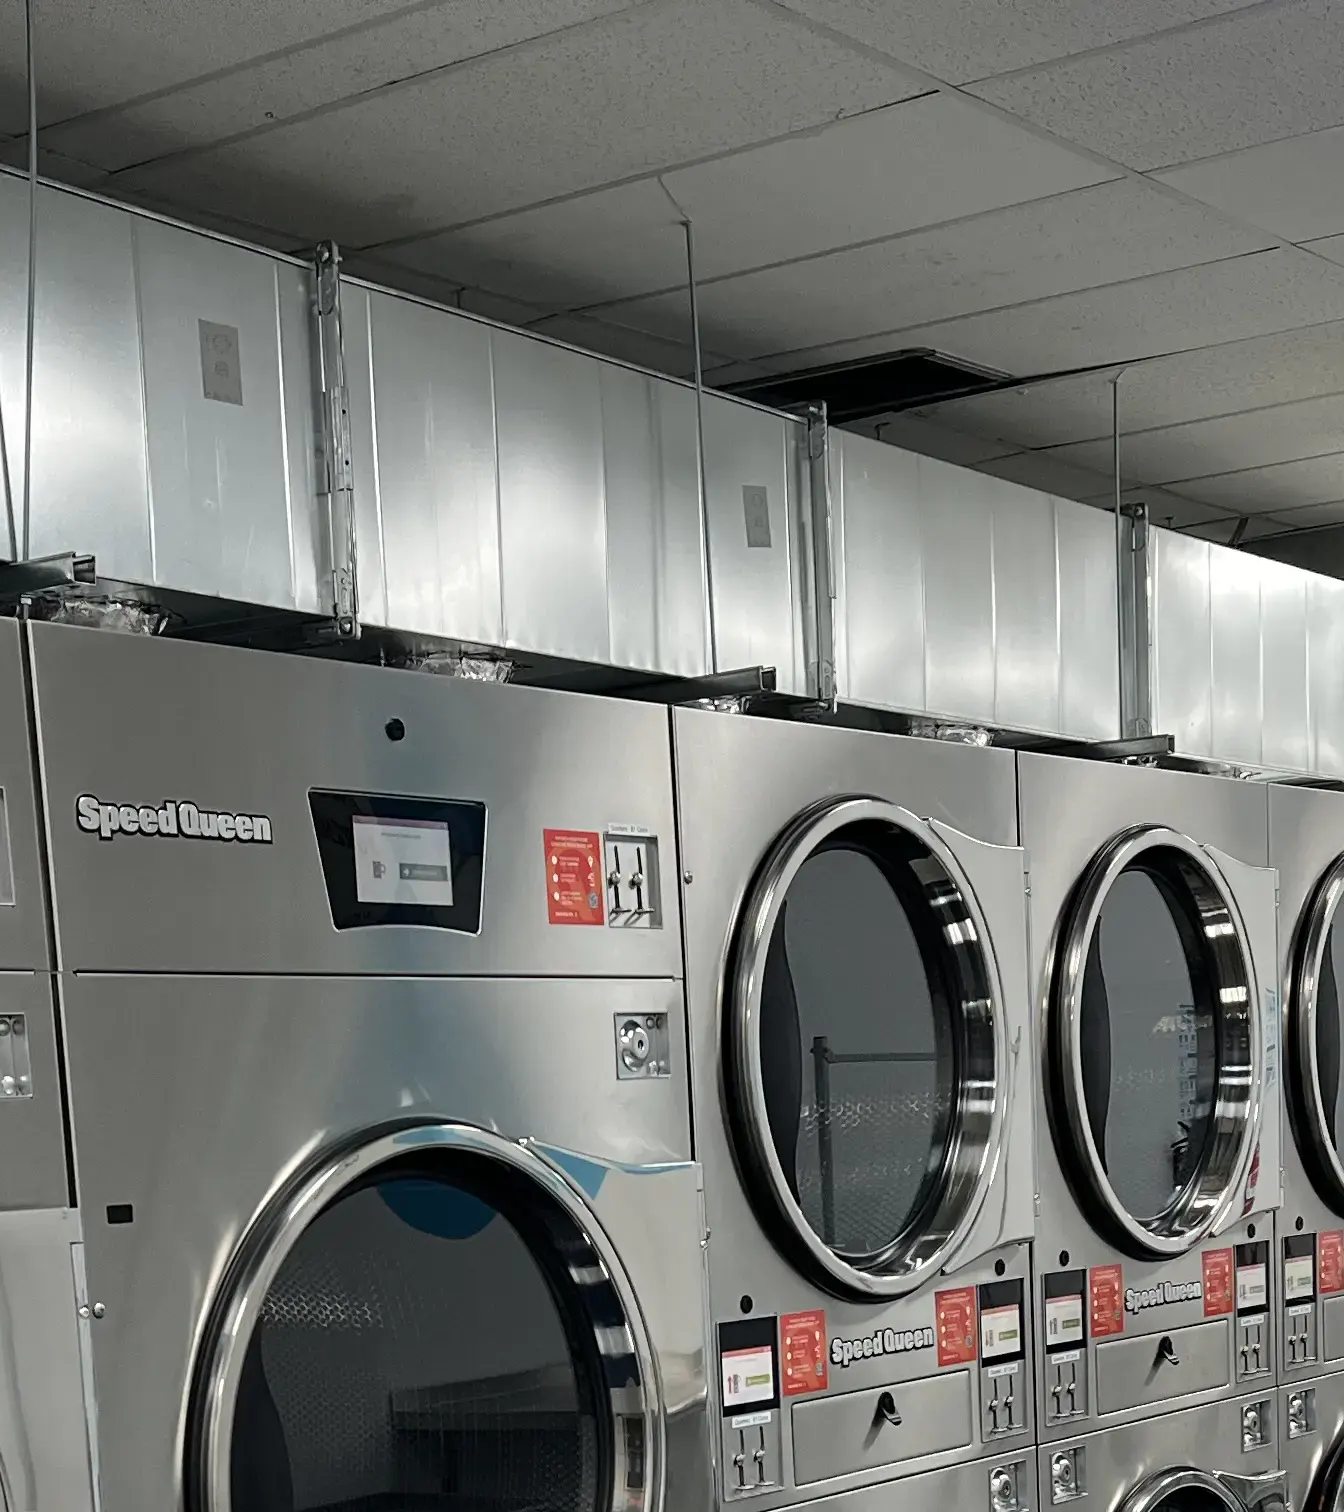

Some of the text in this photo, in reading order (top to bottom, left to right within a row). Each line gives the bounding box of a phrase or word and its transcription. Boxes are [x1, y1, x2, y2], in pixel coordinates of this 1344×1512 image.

[76, 793, 273, 844] Speed Queen
[1125, 1280, 1203, 1315] Speed Queen
[830, 1327, 935, 1369] Speed Queen
